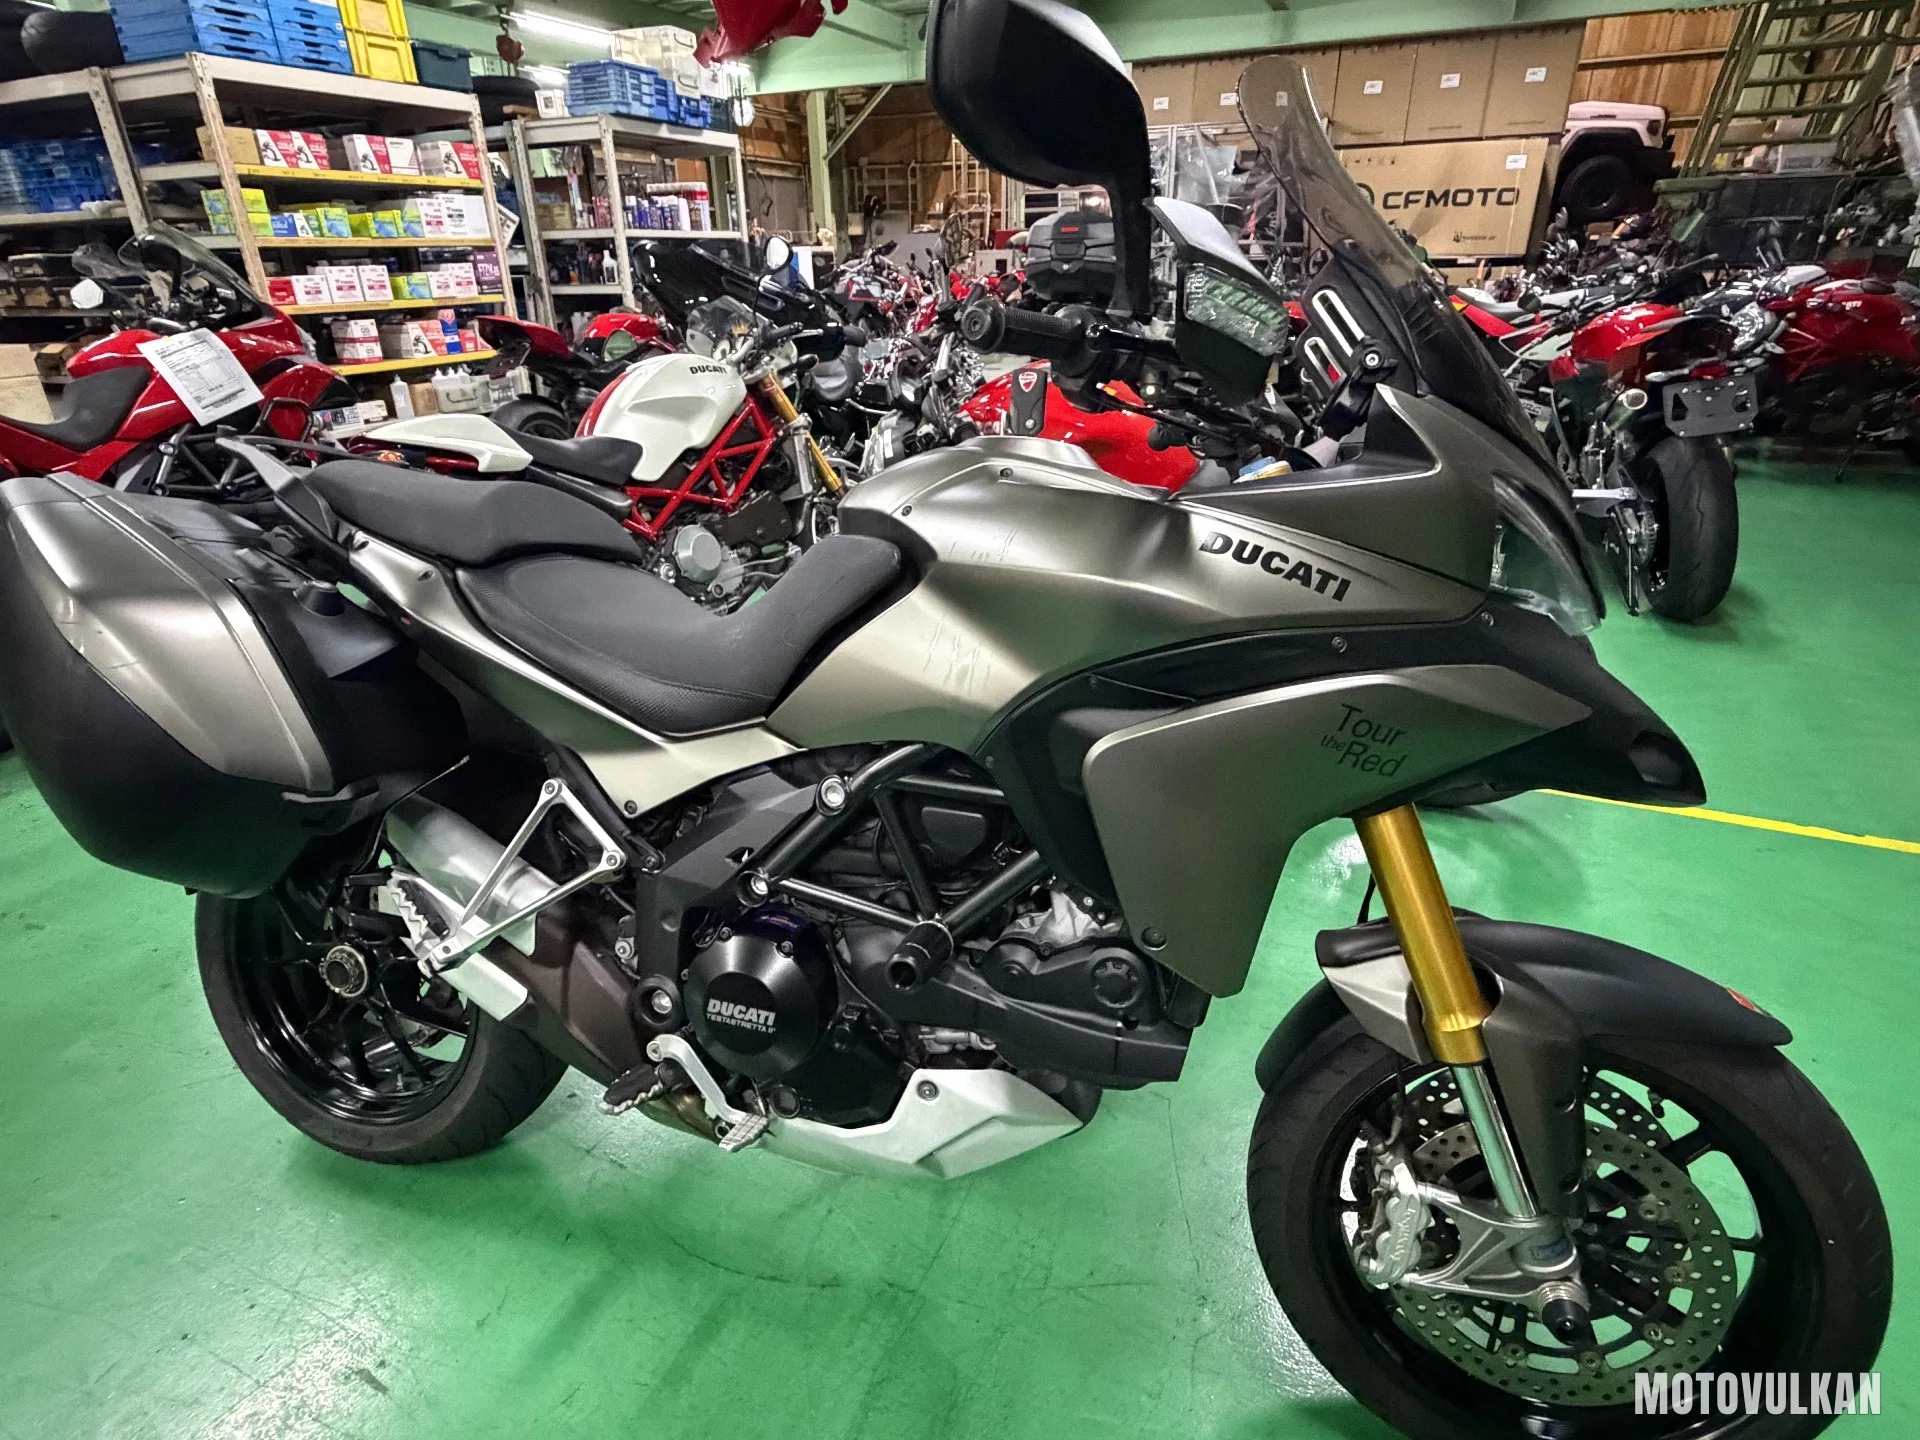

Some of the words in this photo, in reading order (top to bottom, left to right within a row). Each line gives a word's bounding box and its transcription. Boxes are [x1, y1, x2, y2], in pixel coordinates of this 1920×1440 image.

[1382, 187, 1520, 210] CFMOTO
[689, 364, 728, 375] DUCATI
[1199, 531, 1351, 602] DUCATI
[1338, 703, 1409, 748] Tour
[1320, 734, 1347, 752] the
[1336, 740, 1408, 777] Red
[707, 998, 776, 1027] DUCATI
